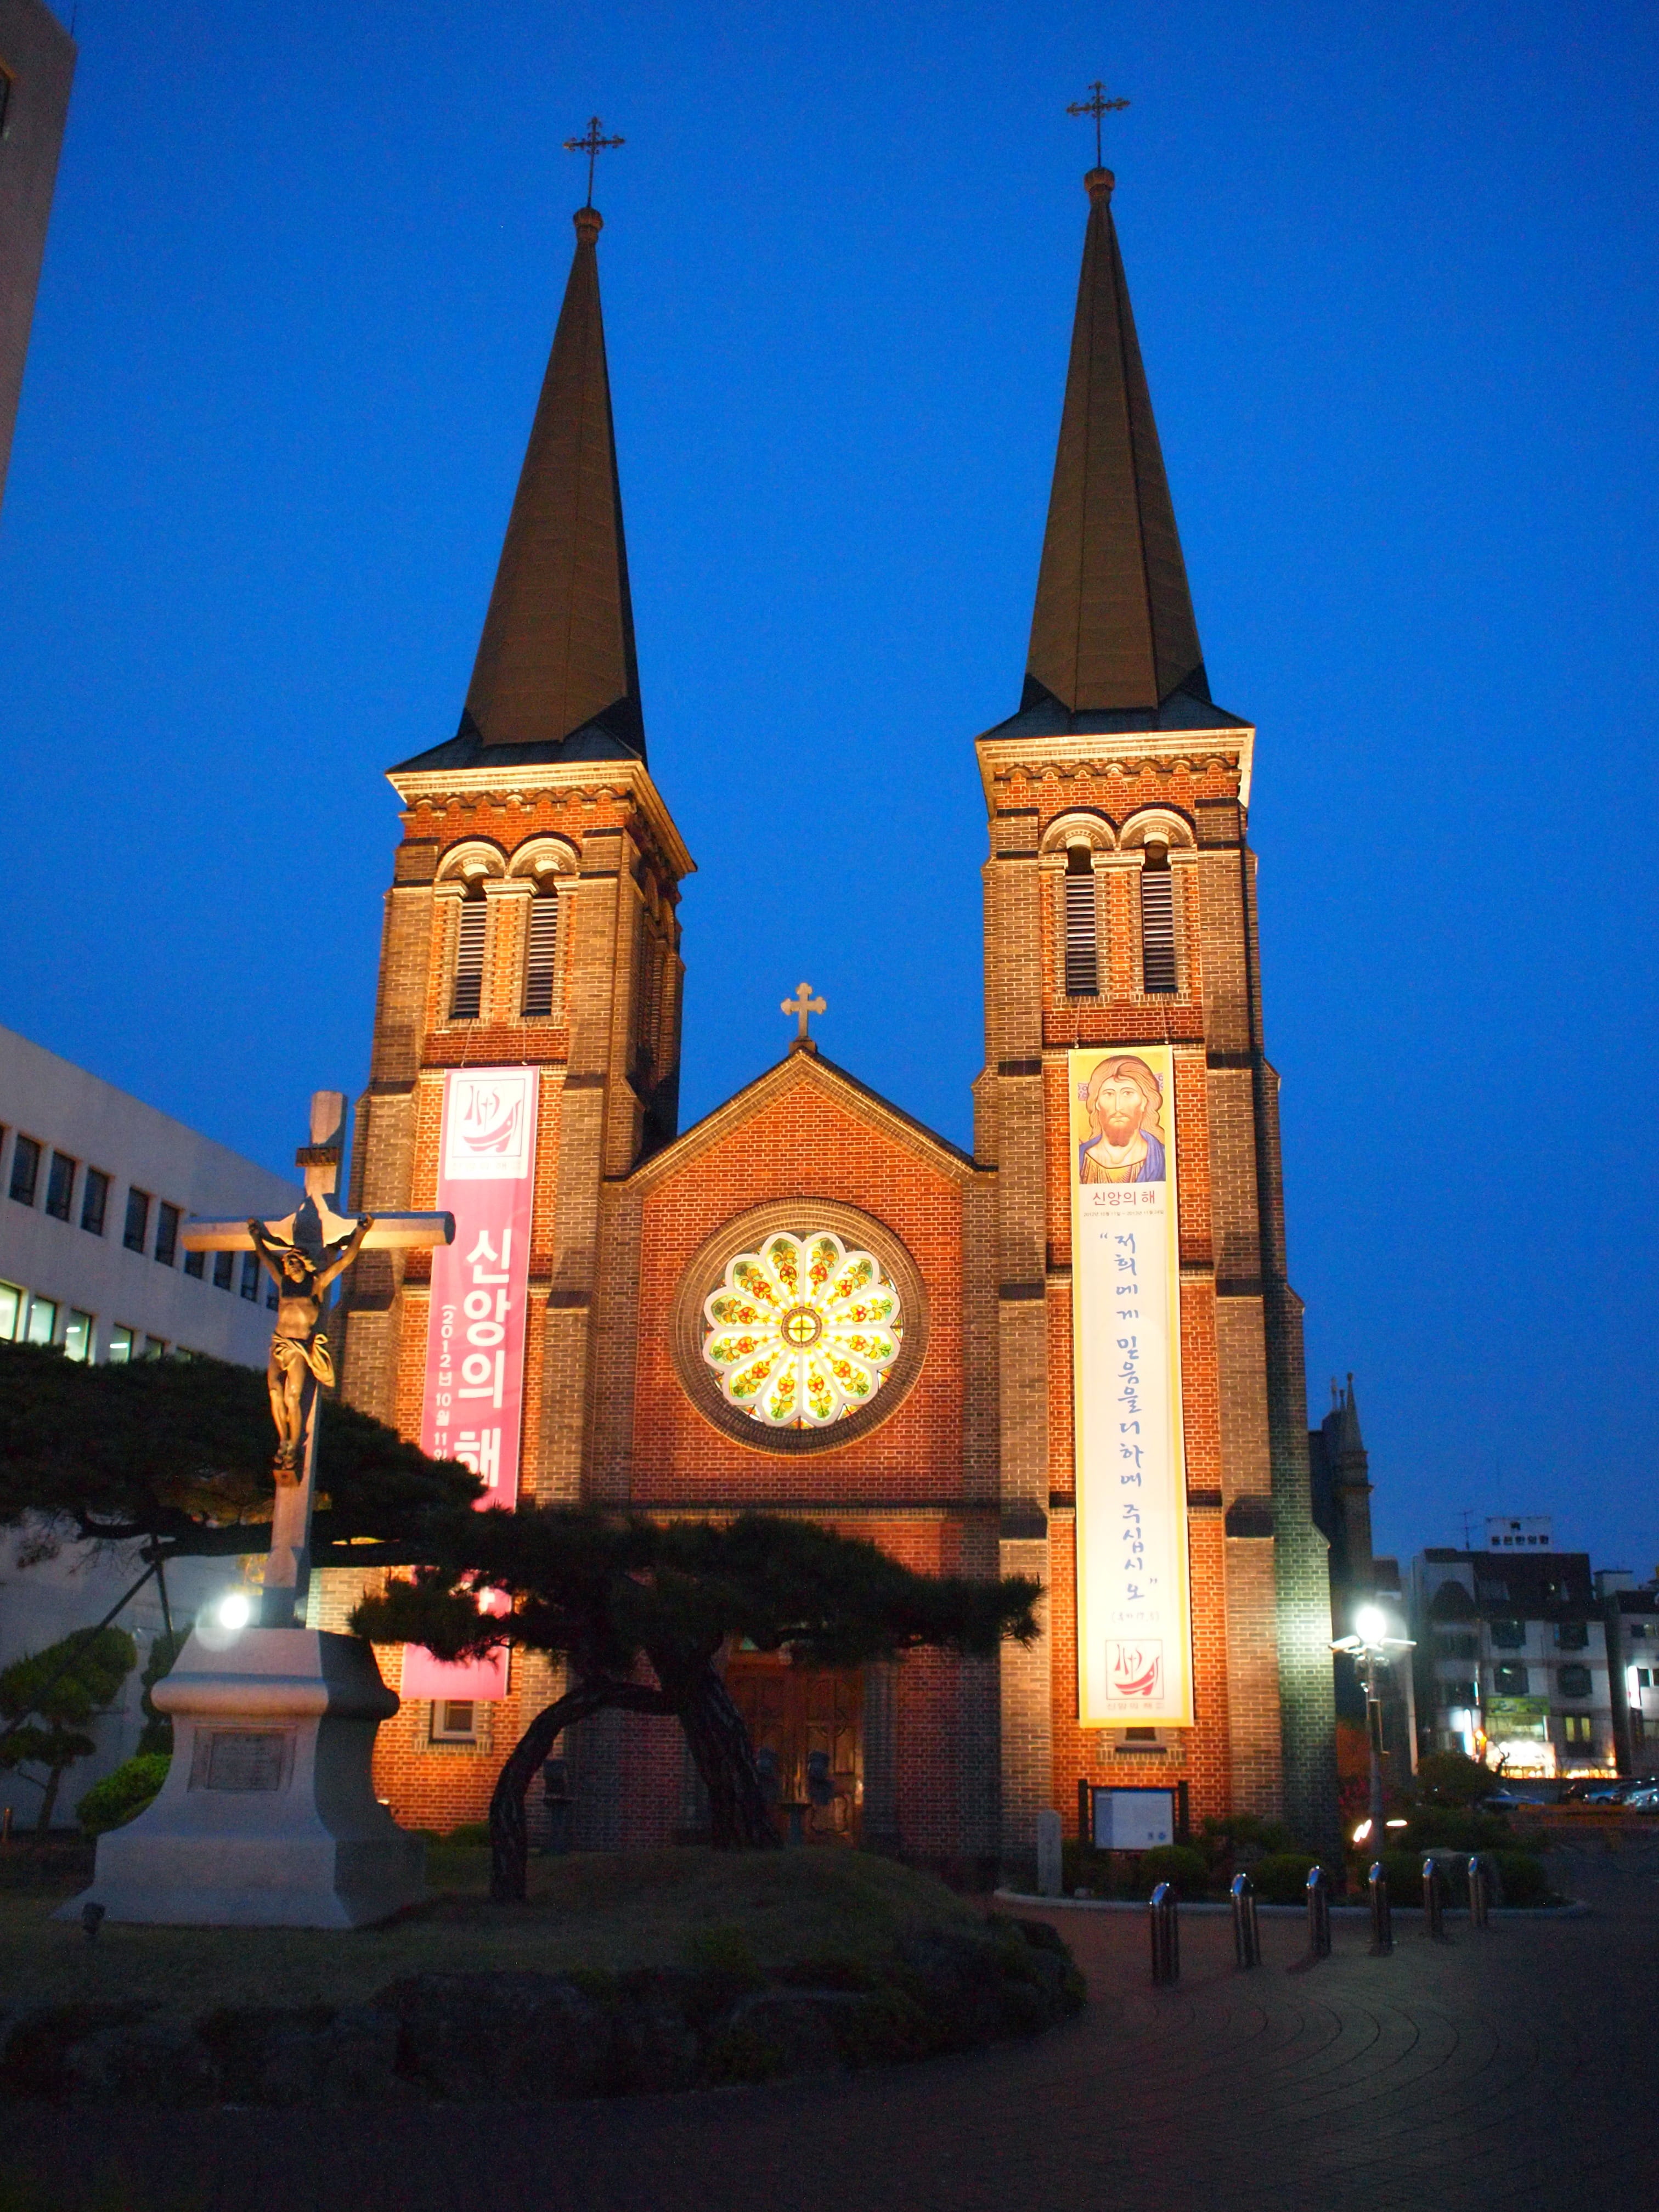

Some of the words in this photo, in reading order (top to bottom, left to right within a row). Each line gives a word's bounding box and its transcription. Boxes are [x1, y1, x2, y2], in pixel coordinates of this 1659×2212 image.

[1093, 1191, 1136, 1206] 신앙의
[1141, 1190, 1155, 1204] 해
[458, 1228, 512, 1409] 신앙의
[1116, 1335, 1142, 1414] 믿음을
[436, 1393, 452, 1426] 10월
[454, 1427, 501, 1488] 해
[1119, 1420, 1144, 1487] 더하여
